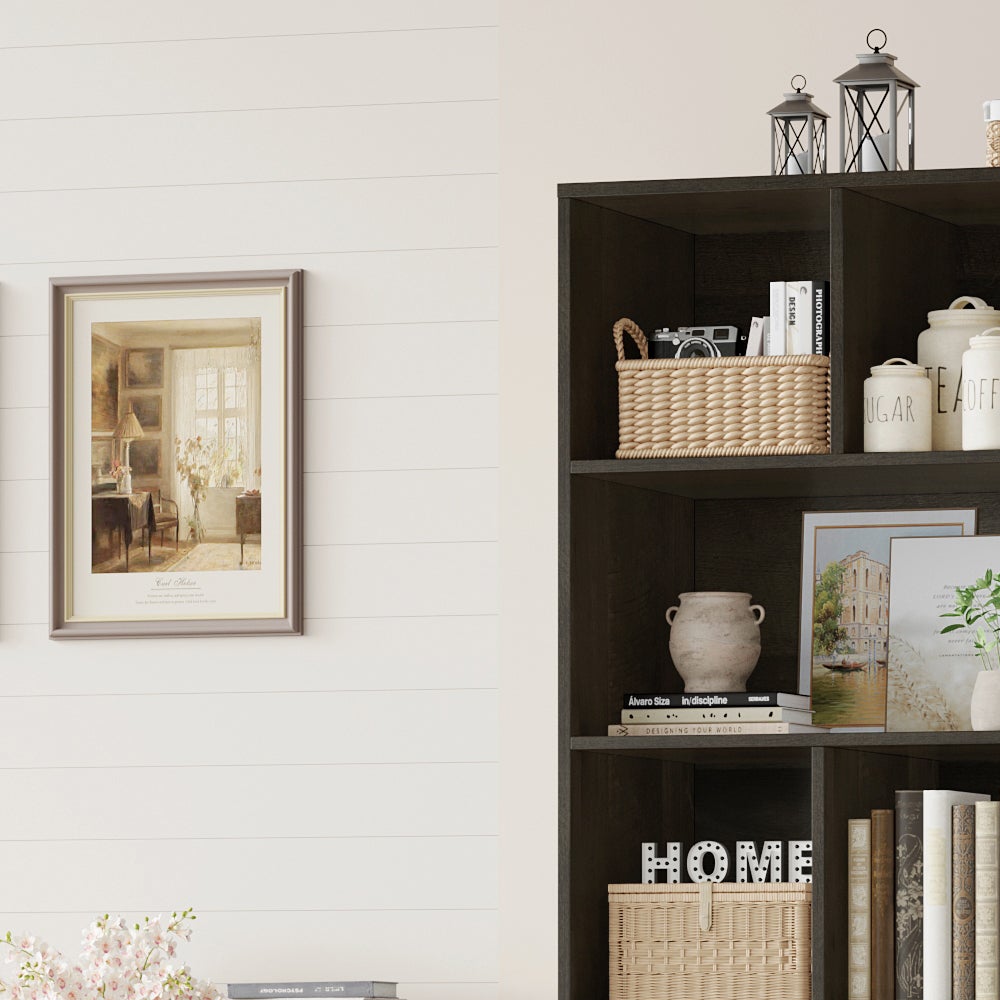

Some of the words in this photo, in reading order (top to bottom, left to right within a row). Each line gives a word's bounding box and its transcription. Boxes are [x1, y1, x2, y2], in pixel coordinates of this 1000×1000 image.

[815, 288, 823, 356] PHOTOGRAPH
[628, 695, 653, 706] Álvaro
[653, 696, 670, 706] Siza
[646, 727, 689, 735] DESIGNING
[641, 840, 813, 884] HOME
